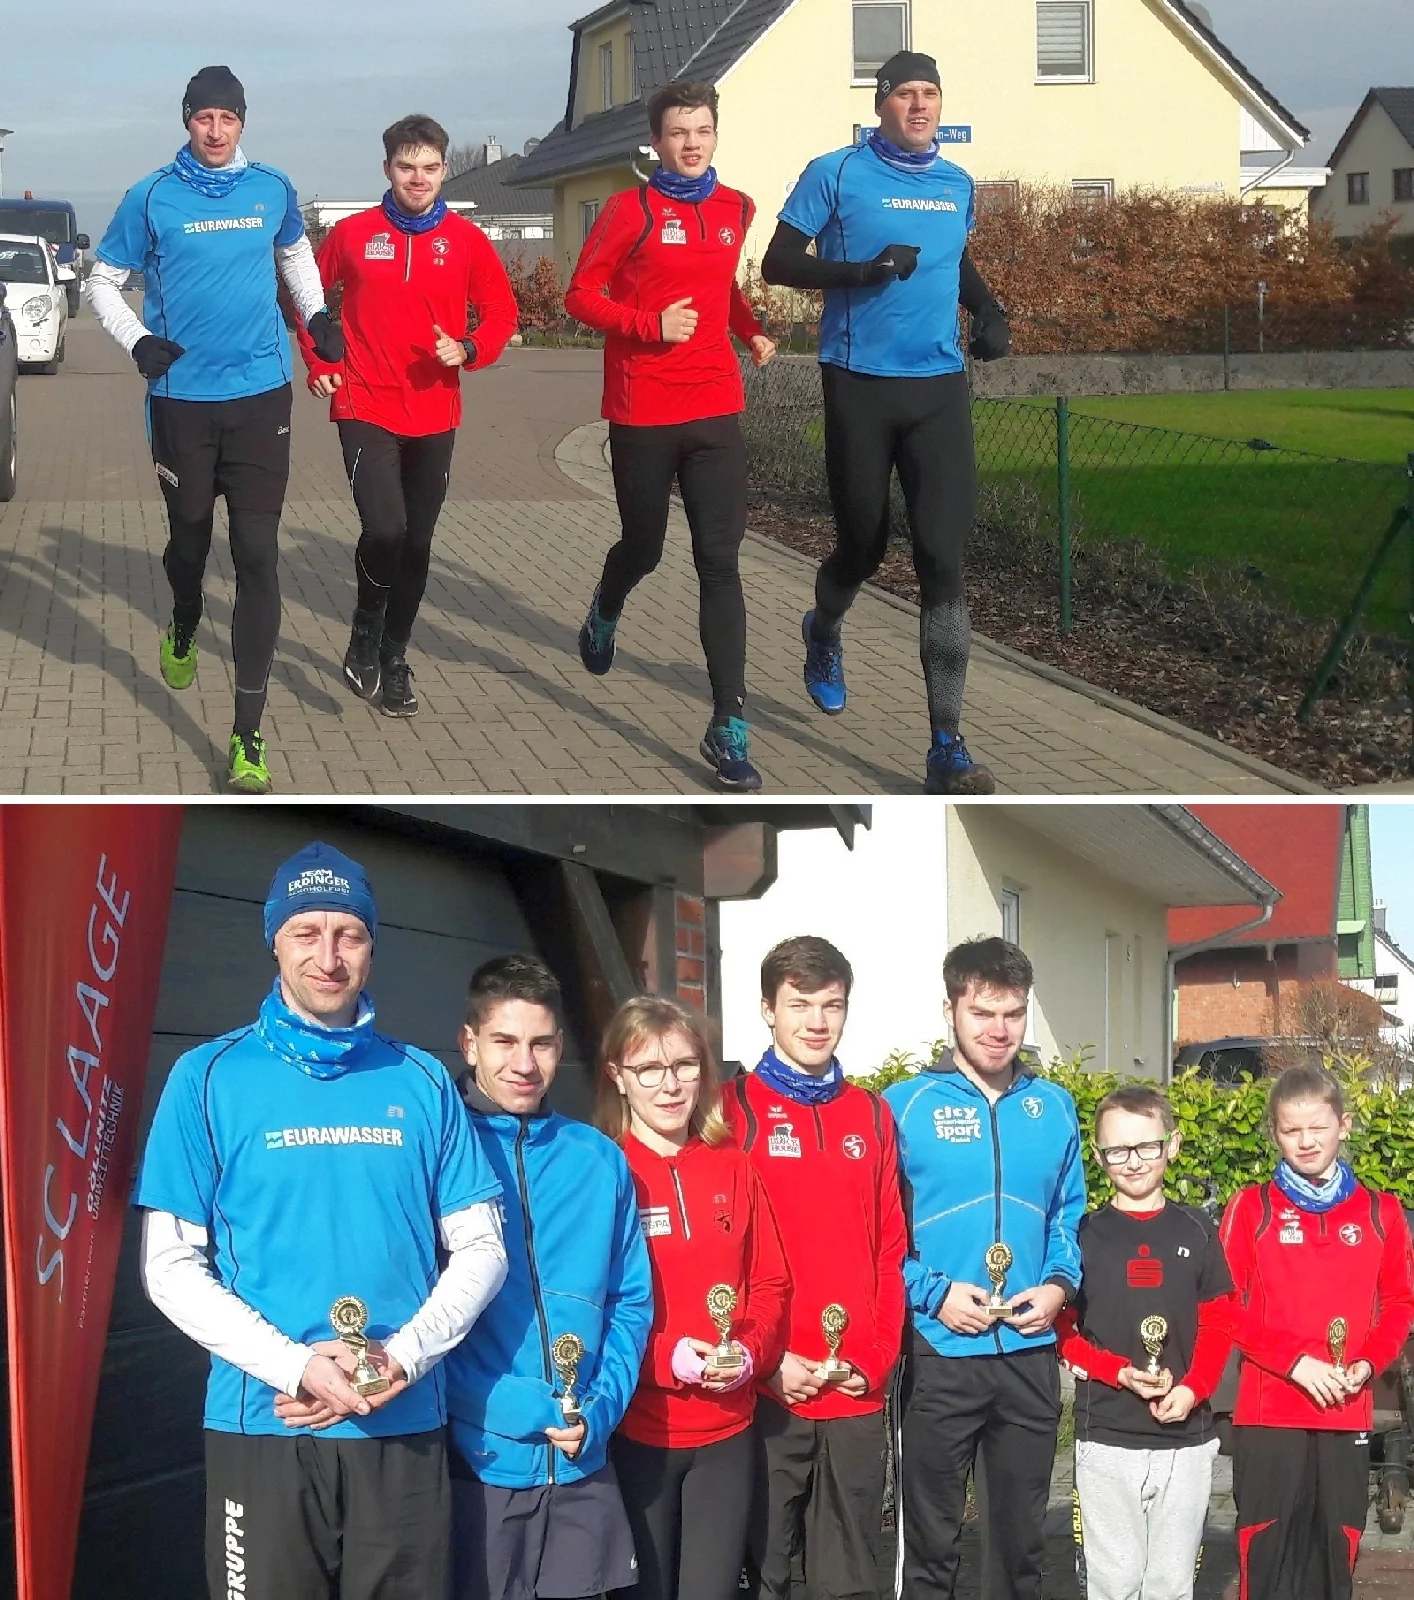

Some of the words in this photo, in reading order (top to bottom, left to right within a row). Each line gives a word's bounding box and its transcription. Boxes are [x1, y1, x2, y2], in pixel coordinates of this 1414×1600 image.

[891, 198, 958, 212] EURAWASSER
[194, 217, 264, 233] EURAWASSER
[300, 868, 333, 878] TEAM
[288, 875, 351, 892] ERDINGER
[56, 852, 131, 1161] LAAGE
[282, 1125, 404, 1148] EURAWASSER
[35, 1163, 78, 1305] SC
